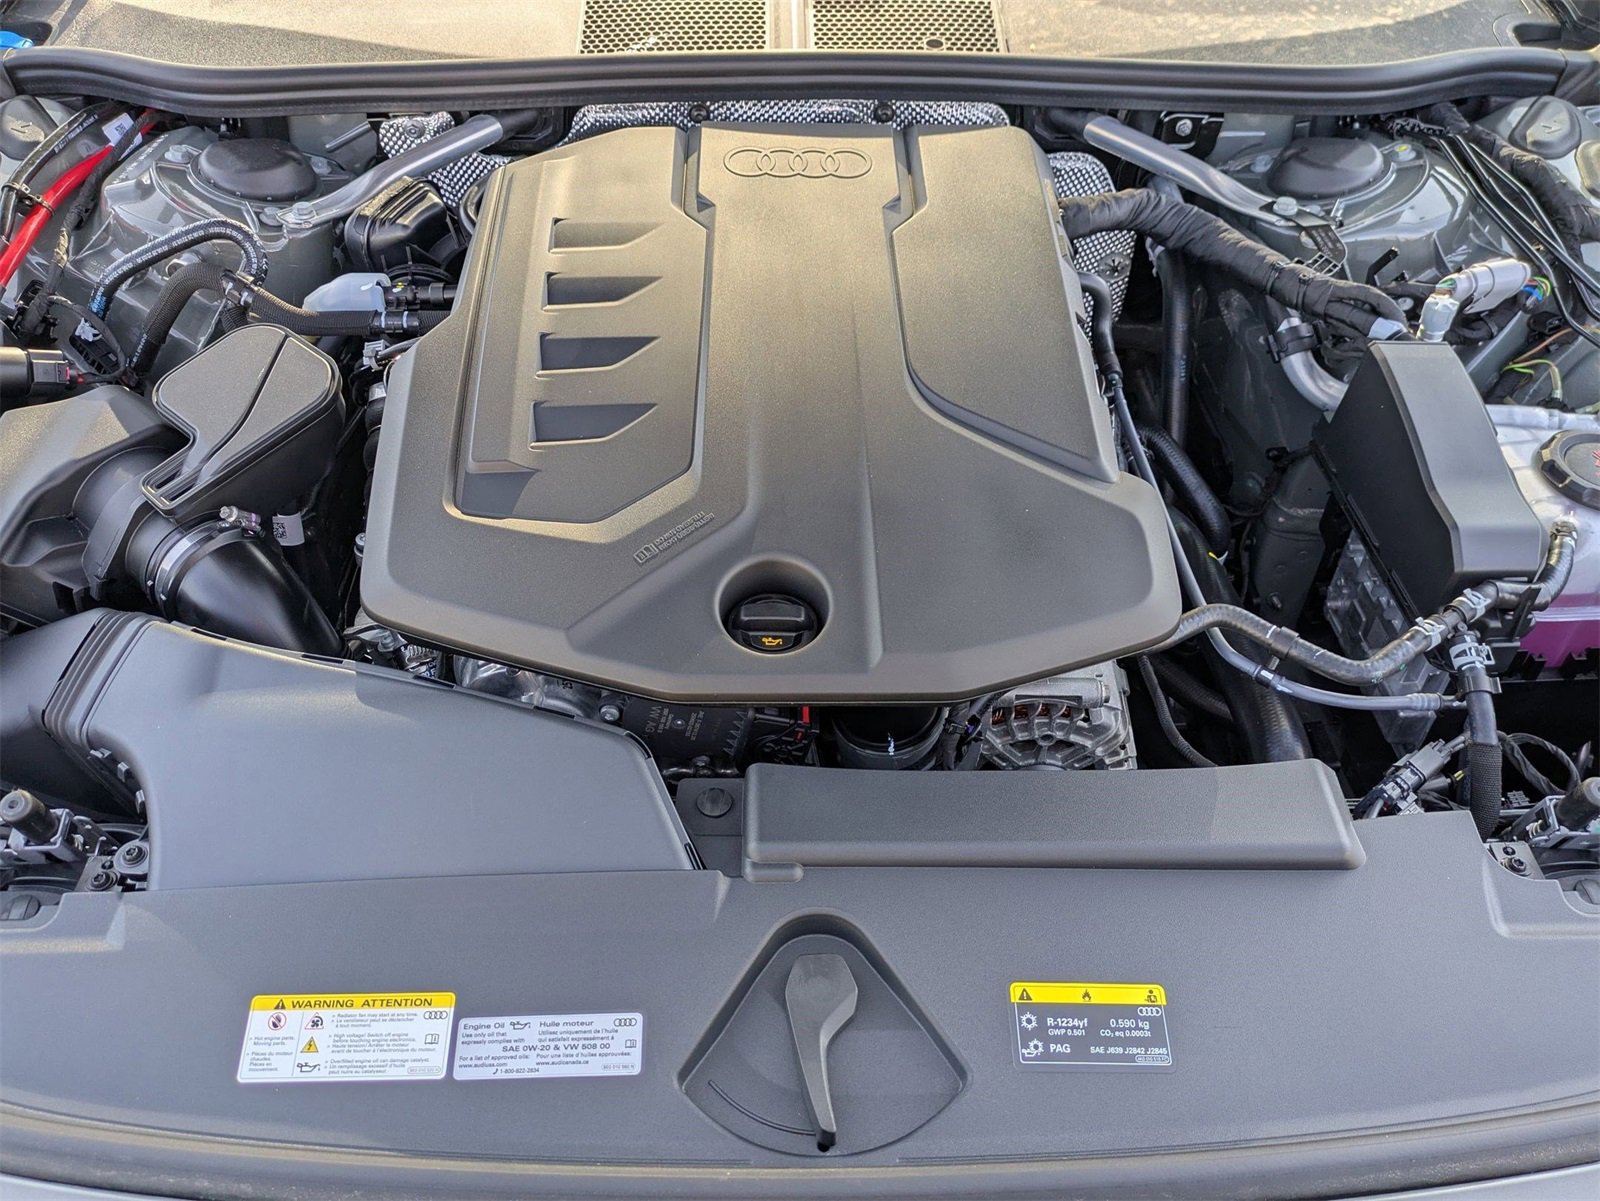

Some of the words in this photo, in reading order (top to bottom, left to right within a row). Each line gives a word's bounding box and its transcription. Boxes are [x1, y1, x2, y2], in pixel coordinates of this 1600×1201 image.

[649, 706, 662, 720] VW
[291, 999, 354, 1009] WARNING
[361, 998, 433, 1008] ATTENTION
[463, 1023, 491, 1031] Engine
[1047, 1017, 1088, 1028] R-1234yf
[1110, 1019, 1135, 1028] 0.590
[1138, 1019, 1150, 1029] kg
[1049, 1044, 1071, 1053] PAG
